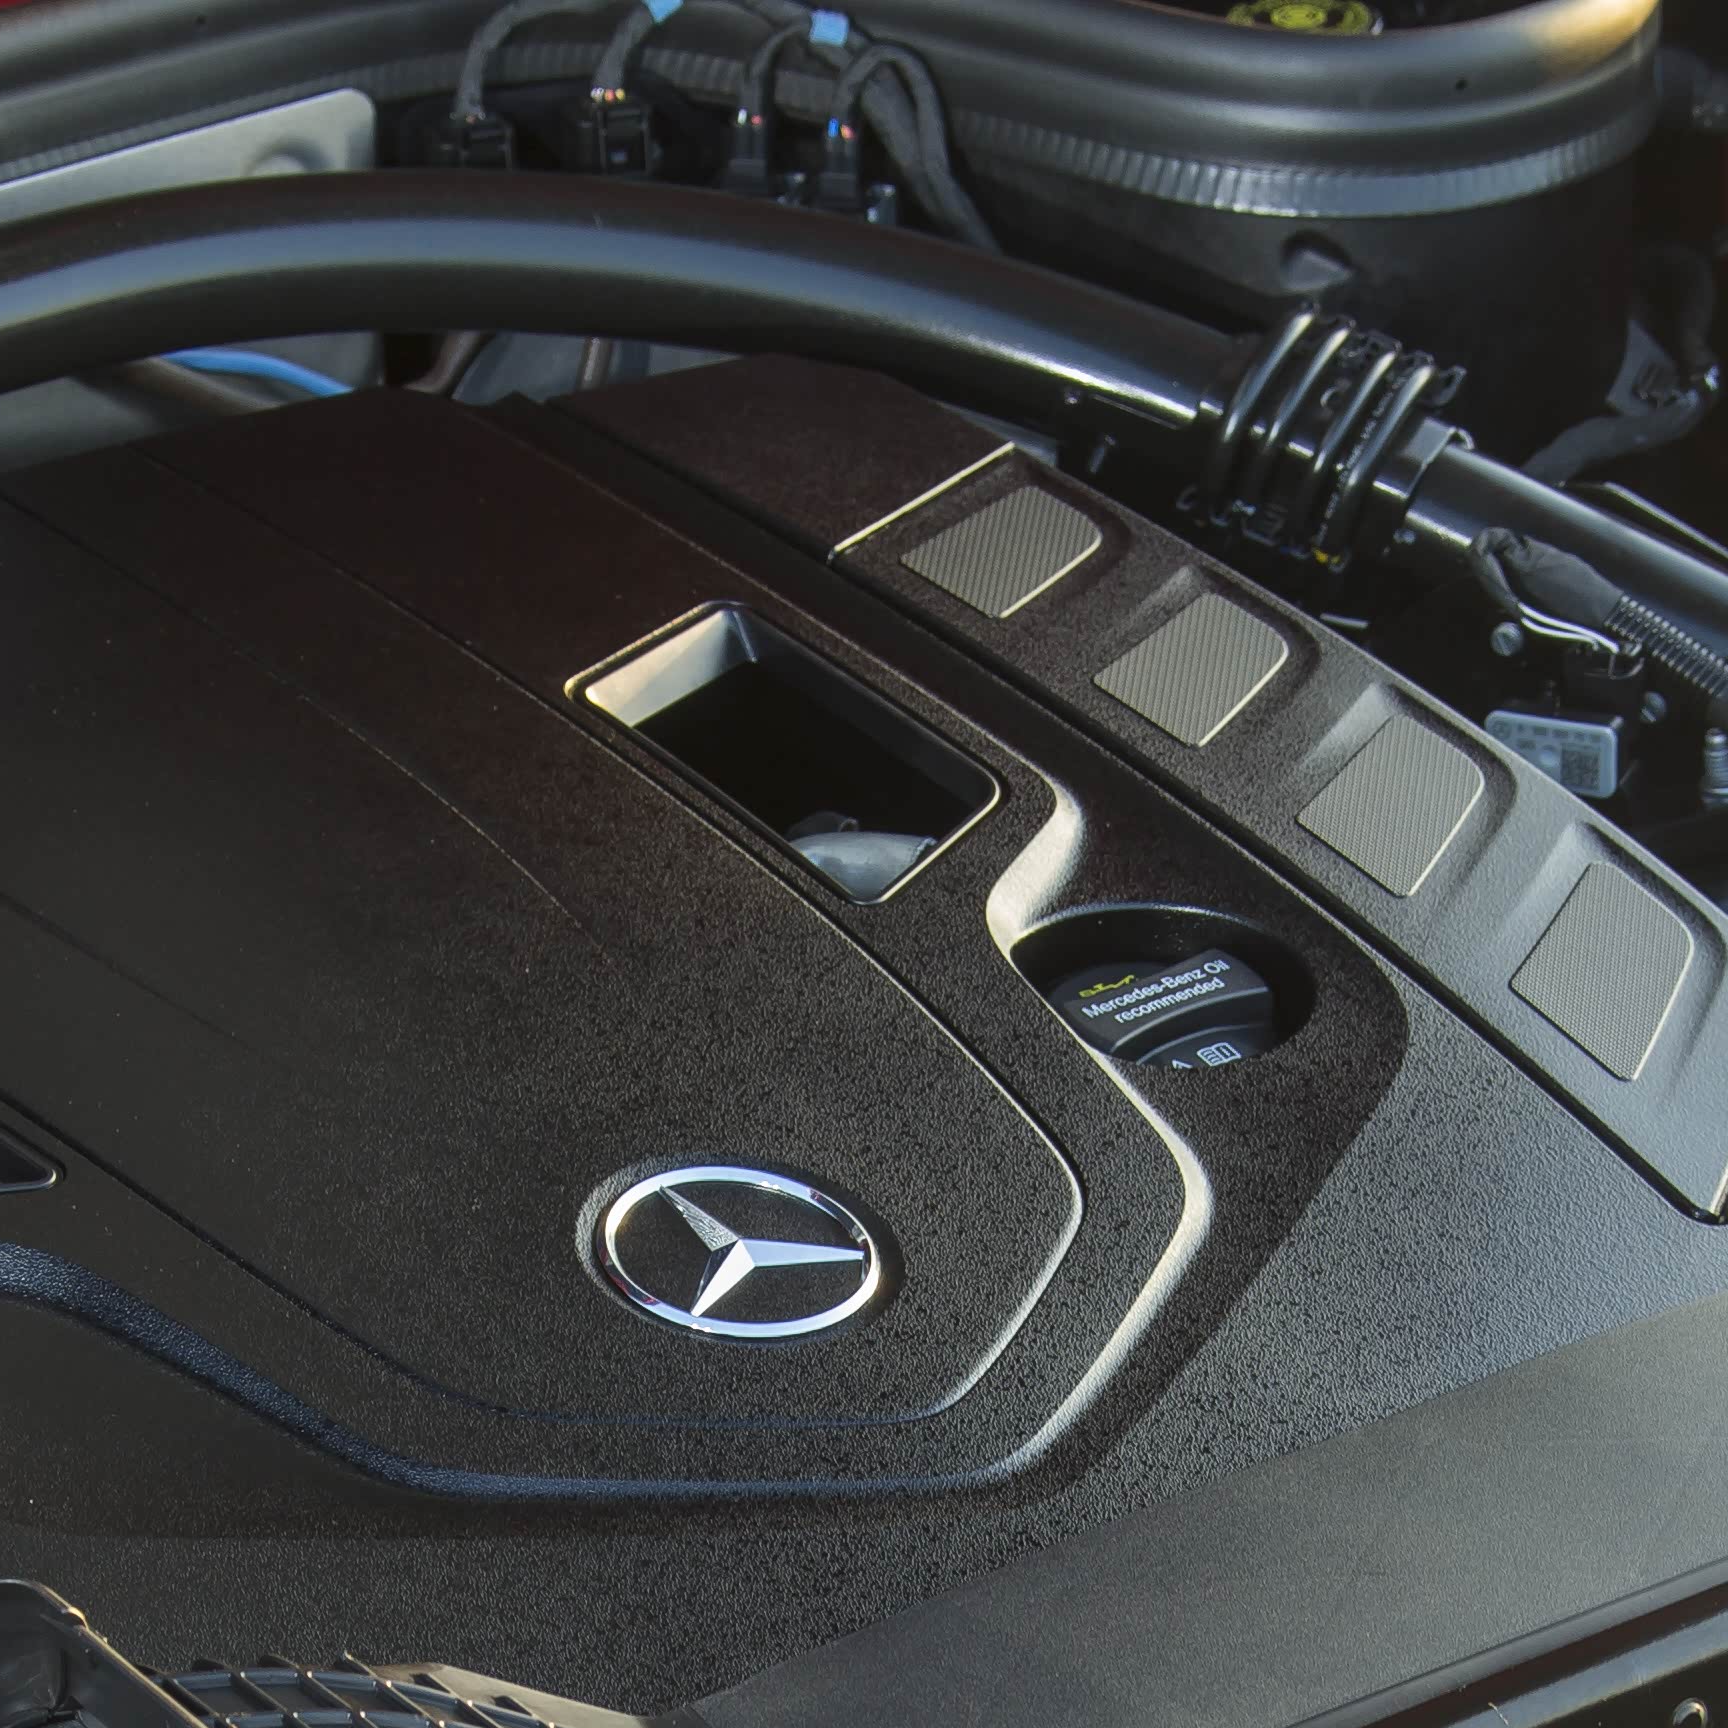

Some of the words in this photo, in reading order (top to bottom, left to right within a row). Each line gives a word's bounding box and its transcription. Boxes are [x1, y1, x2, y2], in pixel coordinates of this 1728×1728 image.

[1081, 968, 1208, 1019] Mercedes-Benz
[1203, 959, 1231, 975] Oil
[1113, 976, 1225, 1024] recommended
